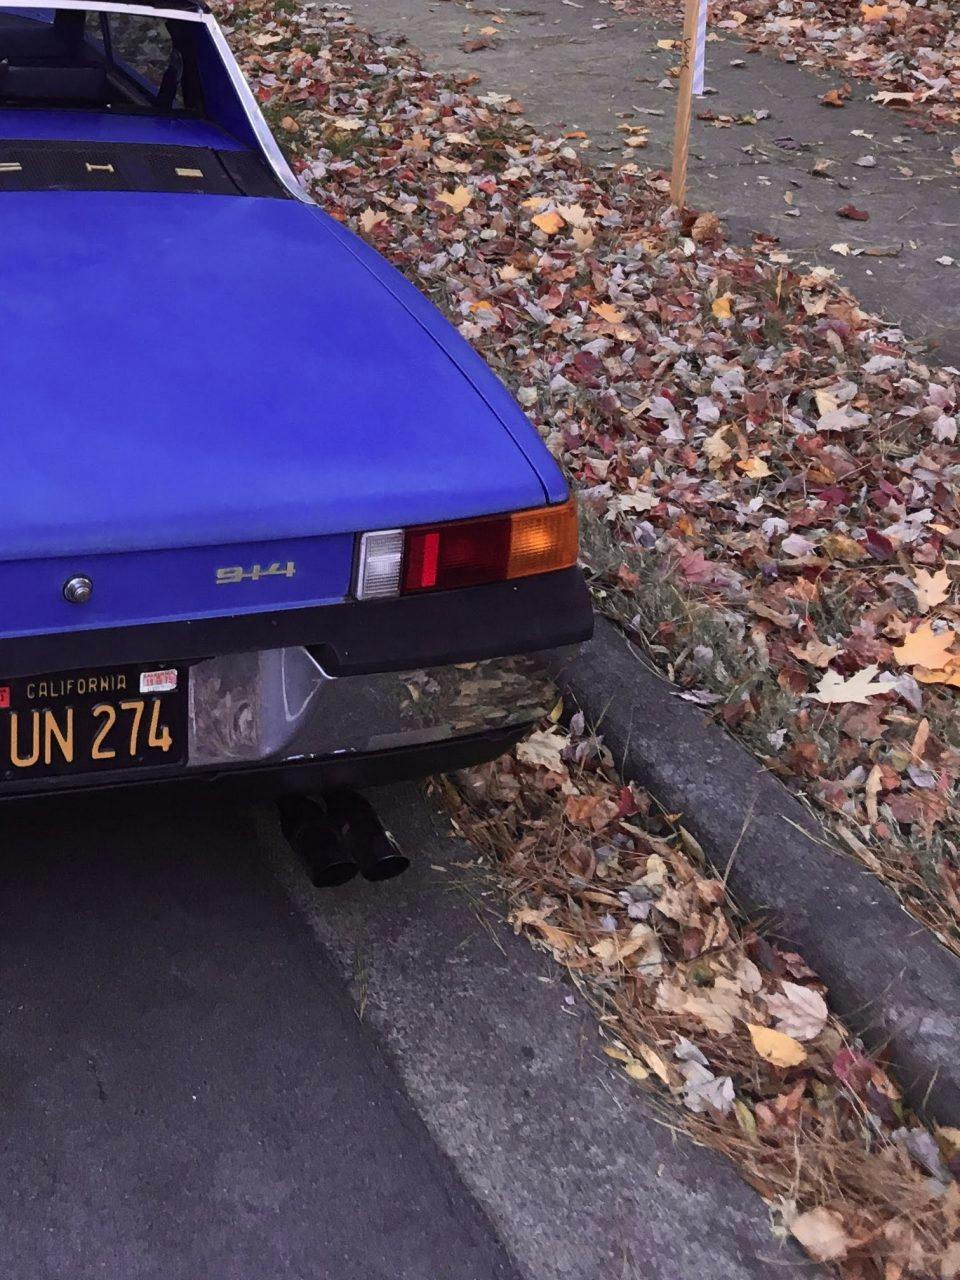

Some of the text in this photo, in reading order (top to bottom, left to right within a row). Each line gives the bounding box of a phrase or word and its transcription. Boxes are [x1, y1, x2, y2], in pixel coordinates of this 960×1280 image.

[216, 561, 296, 585] 914
[26, 674, 127, 699] CALIFORNIA
[91, 699, 173, 760] 274
